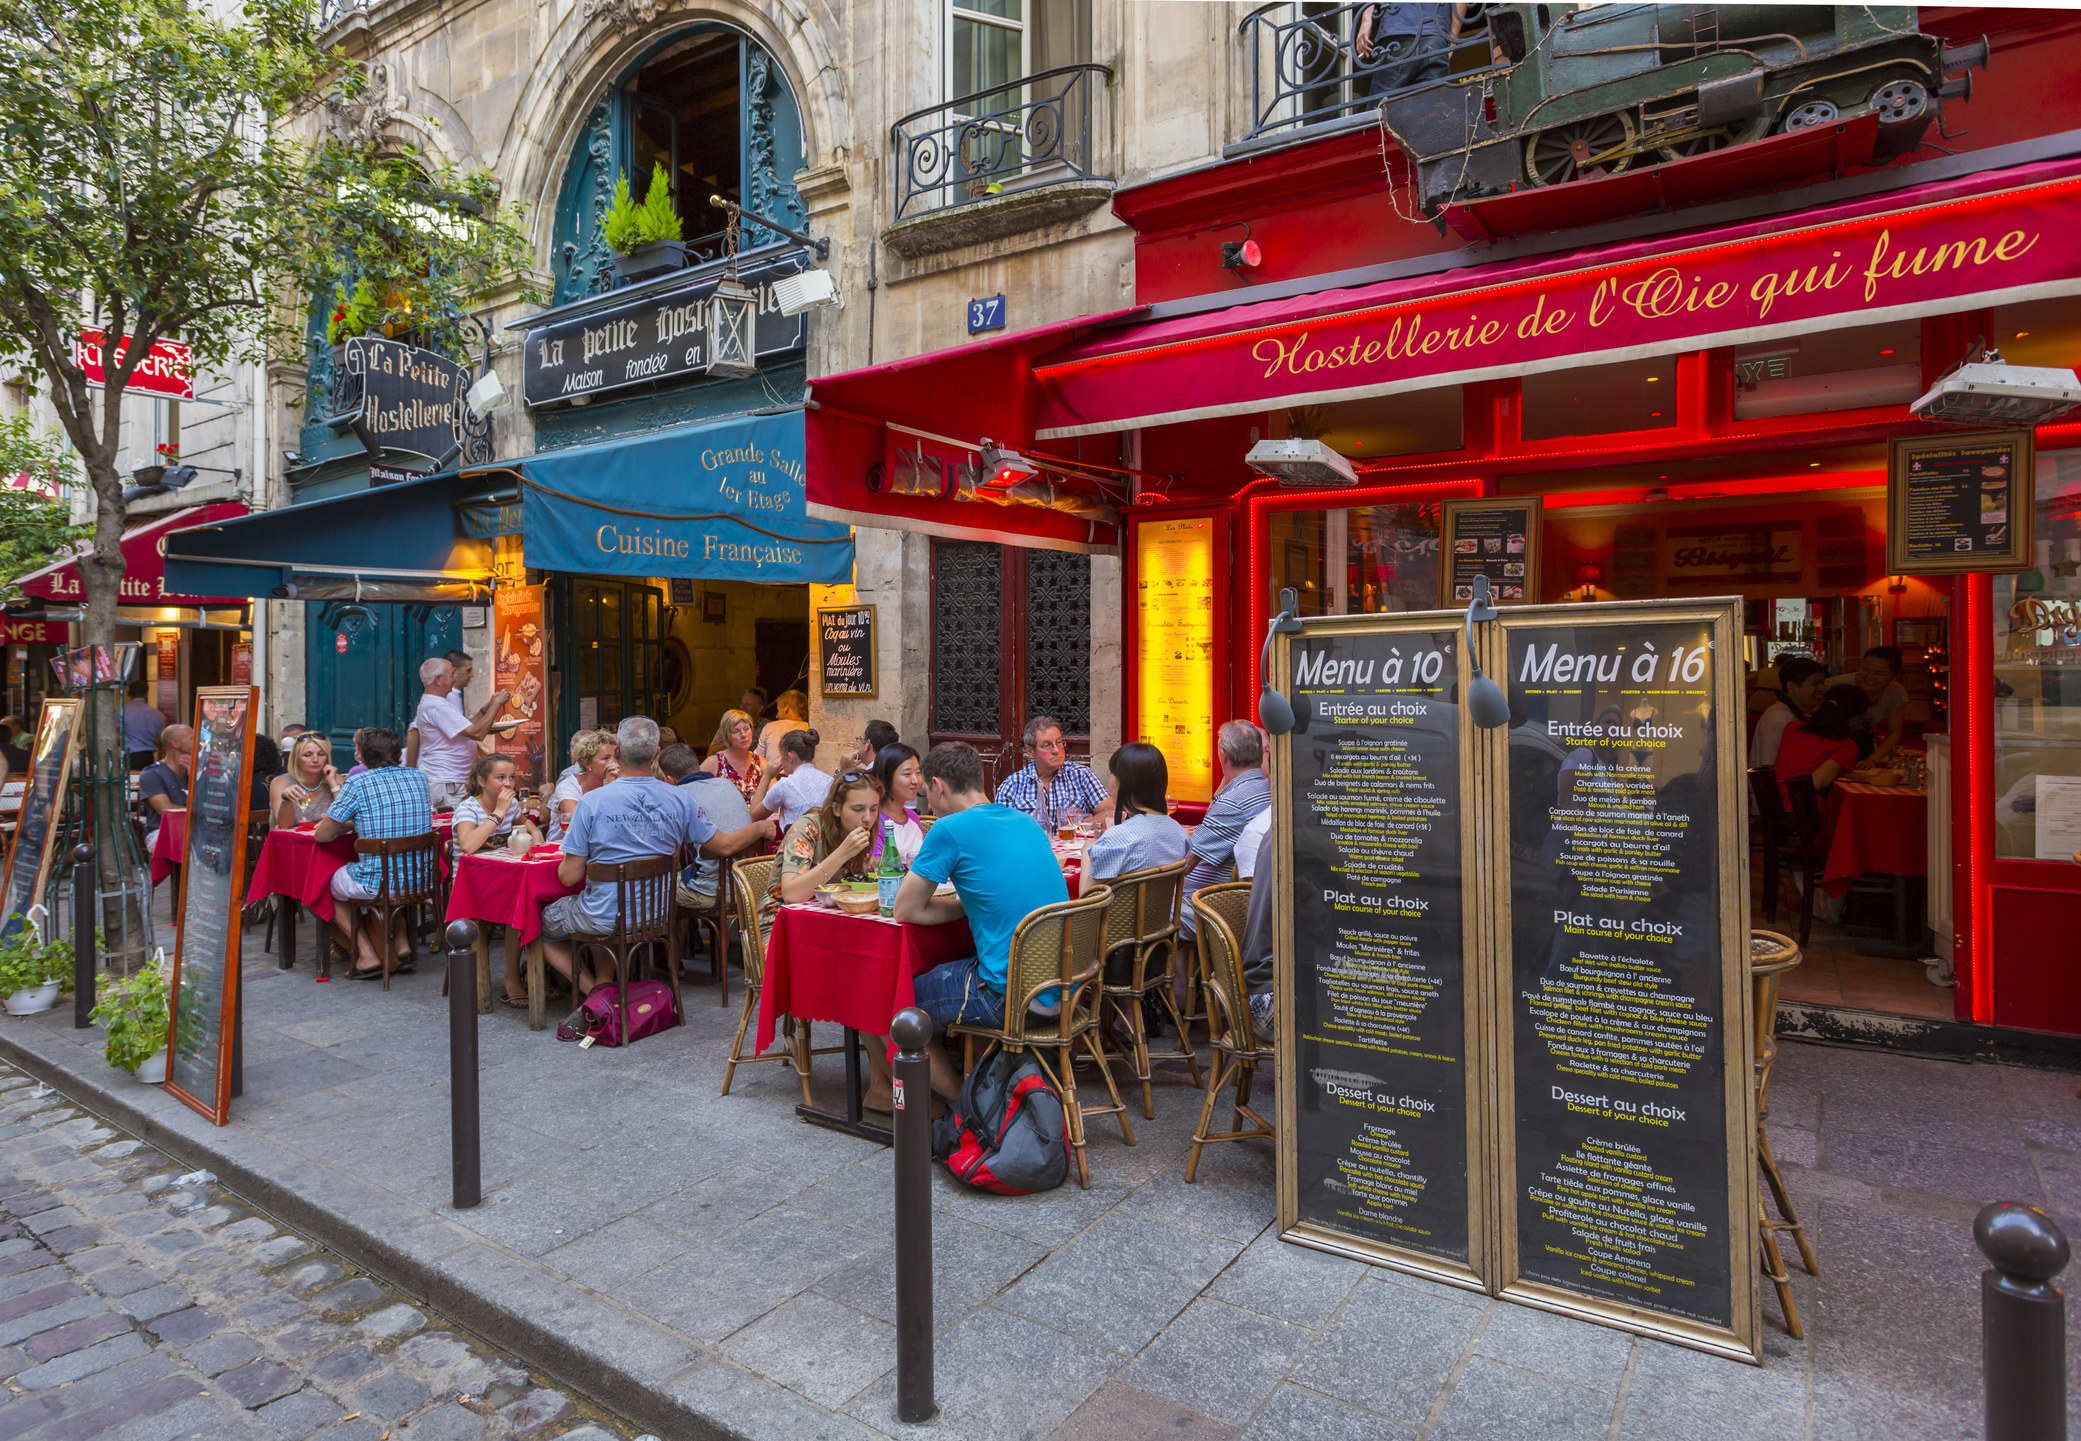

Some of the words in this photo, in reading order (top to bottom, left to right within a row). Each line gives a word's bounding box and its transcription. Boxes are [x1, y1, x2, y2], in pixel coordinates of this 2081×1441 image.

[973, 300, 999, 327] 37
[1252, 314, 1509, 378] Hostellerie
[1517, 294, 1576, 338] de
[1750, 250, 1853, 319] qui
[1863, 228, 2040, 302] fume
[538, 337, 564, 369] La
[369, 343, 392, 374] La
[399, 348, 450, 389] Petite
[562, 370, 603, 394] Maison
[626, 353, 667, 379] fondée
[686, 346, 700, 365] en
[365, 395, 452, 433] Hostellerie
[370, 467, 404, 481] Maison
[701, 442, 764, 470] Grande
[770, 449, 806, 486] Salle
[749, 470, 766, 484] au
[748, 489, 790, 511] Etage
[597, 525, 689, 558] Cuisine
[703, 534, 802, 568] Française
[50, 572, 80, 594] La
[120, 576, 150, 596] tite
[850, 627, 865, 639] vin
[838, 643, 851, 652] ou
[827, 652, 862, 666] Moules
[1296, 650, 1374, 685] Menu
[1382, 647, 1402, 684] à
[1520, 643, 1622, 682] Menu
[1632, 641, 1658, 682] à
[826, 664, 863, 677] marinière
[1320, 702, 1363, 715] Entrée
[1368, 706, 1385, 715] au
[1391, 701, 1426, 715] choix
[1334, 716, 1359, 724] Starter
[1390, 716, 1414, 724] choice
[1548, 721, 1602, 736] Entrée
[1608, 726, 1631, 737] au
[1637, 722, 1682, 738] choix
[1566, 737, 1597, 745] Starter
[1600, 738, 1609, 746] of
[1612, 740, 1633, 748] your
[1636, 739, 1666, 747] choice
[1577, 780, 1624, 788] Charcuteries
[1324, 890, 1356, 903] Plat
[1361, 896, 1381, 906] au
[1387, 896, 1428, 910] choix
[1400, 909, 1421, 917] choice
[1554, 911, 1593, 926] Plat
[1599, 919, 1624, 929] au
[1631, 919, 1682, 935] choix
[1565, 925, 1584, 934] Main
[1587, 929, 1612, 937] course
[1647, 933, 1672, 943] choice
[1358, 1036, 1387, 1046] Tartiflette
[1327, 1081, 1372, 1101] Dessert
[1377, 1094, 1394, 1105] au
[1399, 1096, 1434, 1112] choix
[1340, 1097, 1365, 1107] Dessert
[1397, 1108, 1421, 1117] choice
[1552, 1086, 1608, 1108] Dessert
[1614, 1101, 1636, 1112] au
[1642, 1102, 1685, 1121] choix
[1568, 1103, 1599, 1115] Dessert
[1615, 1113, 1636, 1121] your
[1639, 1116, 1668, 1127] choice
[1364, 1123, 1395, 1135] Fromage
[1358, 1135, 1379, 1144] Crème
[1381, 1139, 1401, 1149] brûlée
[1587, 1137, 1613, 1148] Crème
[1615, 1142, 1640, 1153] brûlée
[1577, 1150, 1585, 1159] Ile
[1587, 1153, 1621, 1166] flottante
[1624, 1161, 1652, 1172] géante
[1556, 1163, 1587, 1175] Assiette
[1590, 1170, 1601, 1178] de
[1604, 1172, 1644, 1187] fromages
[1647, 1182, 1676, 1193] affinés
[1541, 1172, 1561, 1184] Tarte
[1564, 1178, 1583, 1189] tiède
[1603, 1188, 1640, 1201] pommes,
[1642, 1195, 1664, 1205] glace
[1667, 1201, 1695, 1212] vanille
[1529, 1187, 1553, 1198] Crêpe
[1568, 1197, 1596, 1208] gaufre
[1613, 1205, 1647, 1220] Nutella,
[1650, 1214, 1674, 1225] glace
[1677, 1221, 1707, 1232] vanille
[1549, 1206, 1593, 1223] Profiterole
[1610, 1221, 1646, 1235] chocolat
[1649, 1229, 1677, 1241] chaud
[1572, 1227, 1600, 1240] Salade
[1602, 1235, 1612, 1243] de
[1615, 1237, 1636, 1249] fruits
[1638, 1242, 1656, 1253] frais
[1588, 1247, 1612, 1259] Coupe
[1615, 1254, 1650, 1268] Amarena
[1591, 1263, 1616, 1276] Coupe
[1618, 1272, 1646, 1283] colonel
